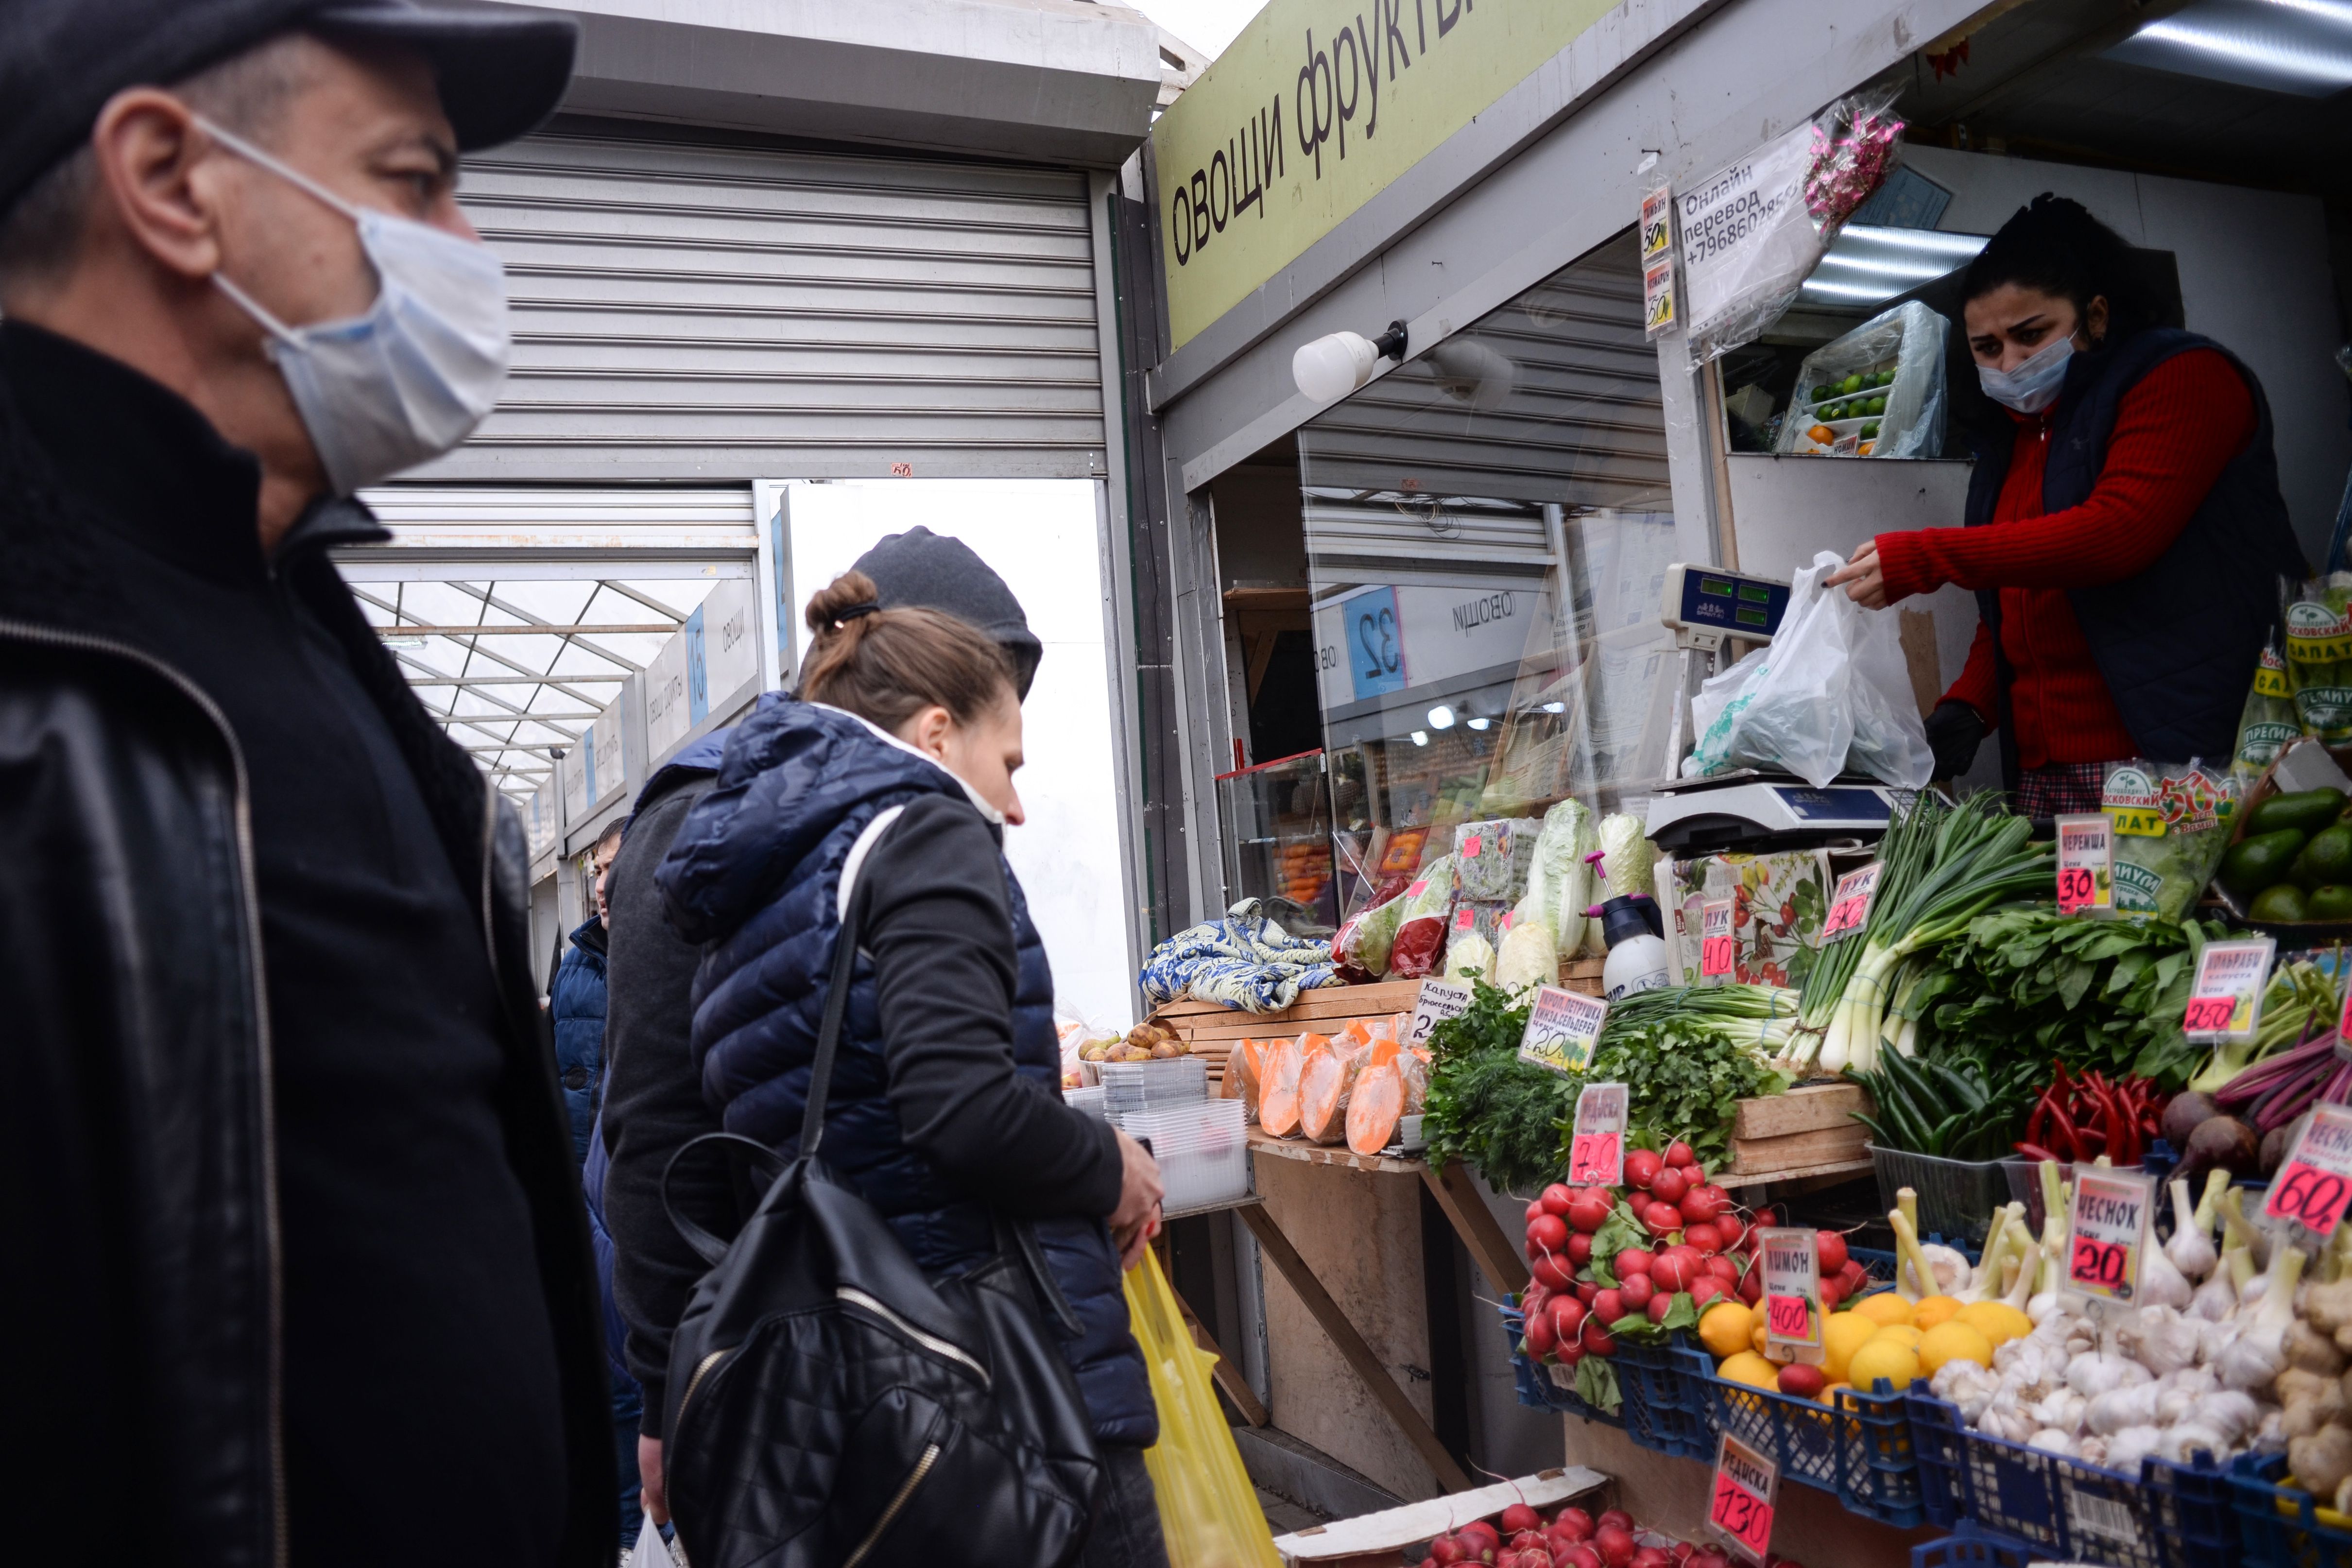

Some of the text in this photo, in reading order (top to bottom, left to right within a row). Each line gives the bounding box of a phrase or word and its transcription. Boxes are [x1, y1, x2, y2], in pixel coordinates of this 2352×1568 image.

[1172, 93, 1284, 266] овощи
[1685, 165, 1753, 216] Онлайн
[1644, 197, 1666, 221] ТИМЬЯН
[1684, 190, 1760, 244] перевод
[1644, 222, 1661, 252] 50
[1648, 270, 1669, 290] РОЗМАРИН
[1647, 295, 1665, 325] 50
[723, 606, 745, 653] овощи
[690, 628, 704, 705] 15
[2062, 833, 2106, 851] ЧЕРЕМША
[1838, 872, 1875, 896] ЛУК
[2060, 868, 2092, 901] 30
[1705, 909, 1729, 928] ЛУК
[1703, 938, 1731, 970] 40
[2207, 951, 2263, 970] КОЛЬРАБИ
[1539, 990, 1602, 1022] УКРОП, ПЕТРУШКА
[1533, 1028, 1565, 1056] 20
[2078, 1194, 2140, 1230] ЧЕСНОК
[1768, 1250, 1809, 1274] ЛИМОН
[2075, 1244, 2125, 1284] 20
[1771, 1299, 1804, 1330] 400
[1722, 1449, 1768, 1495] РЕДИСКА
[1719, 1489, 1767, 1543] 130
